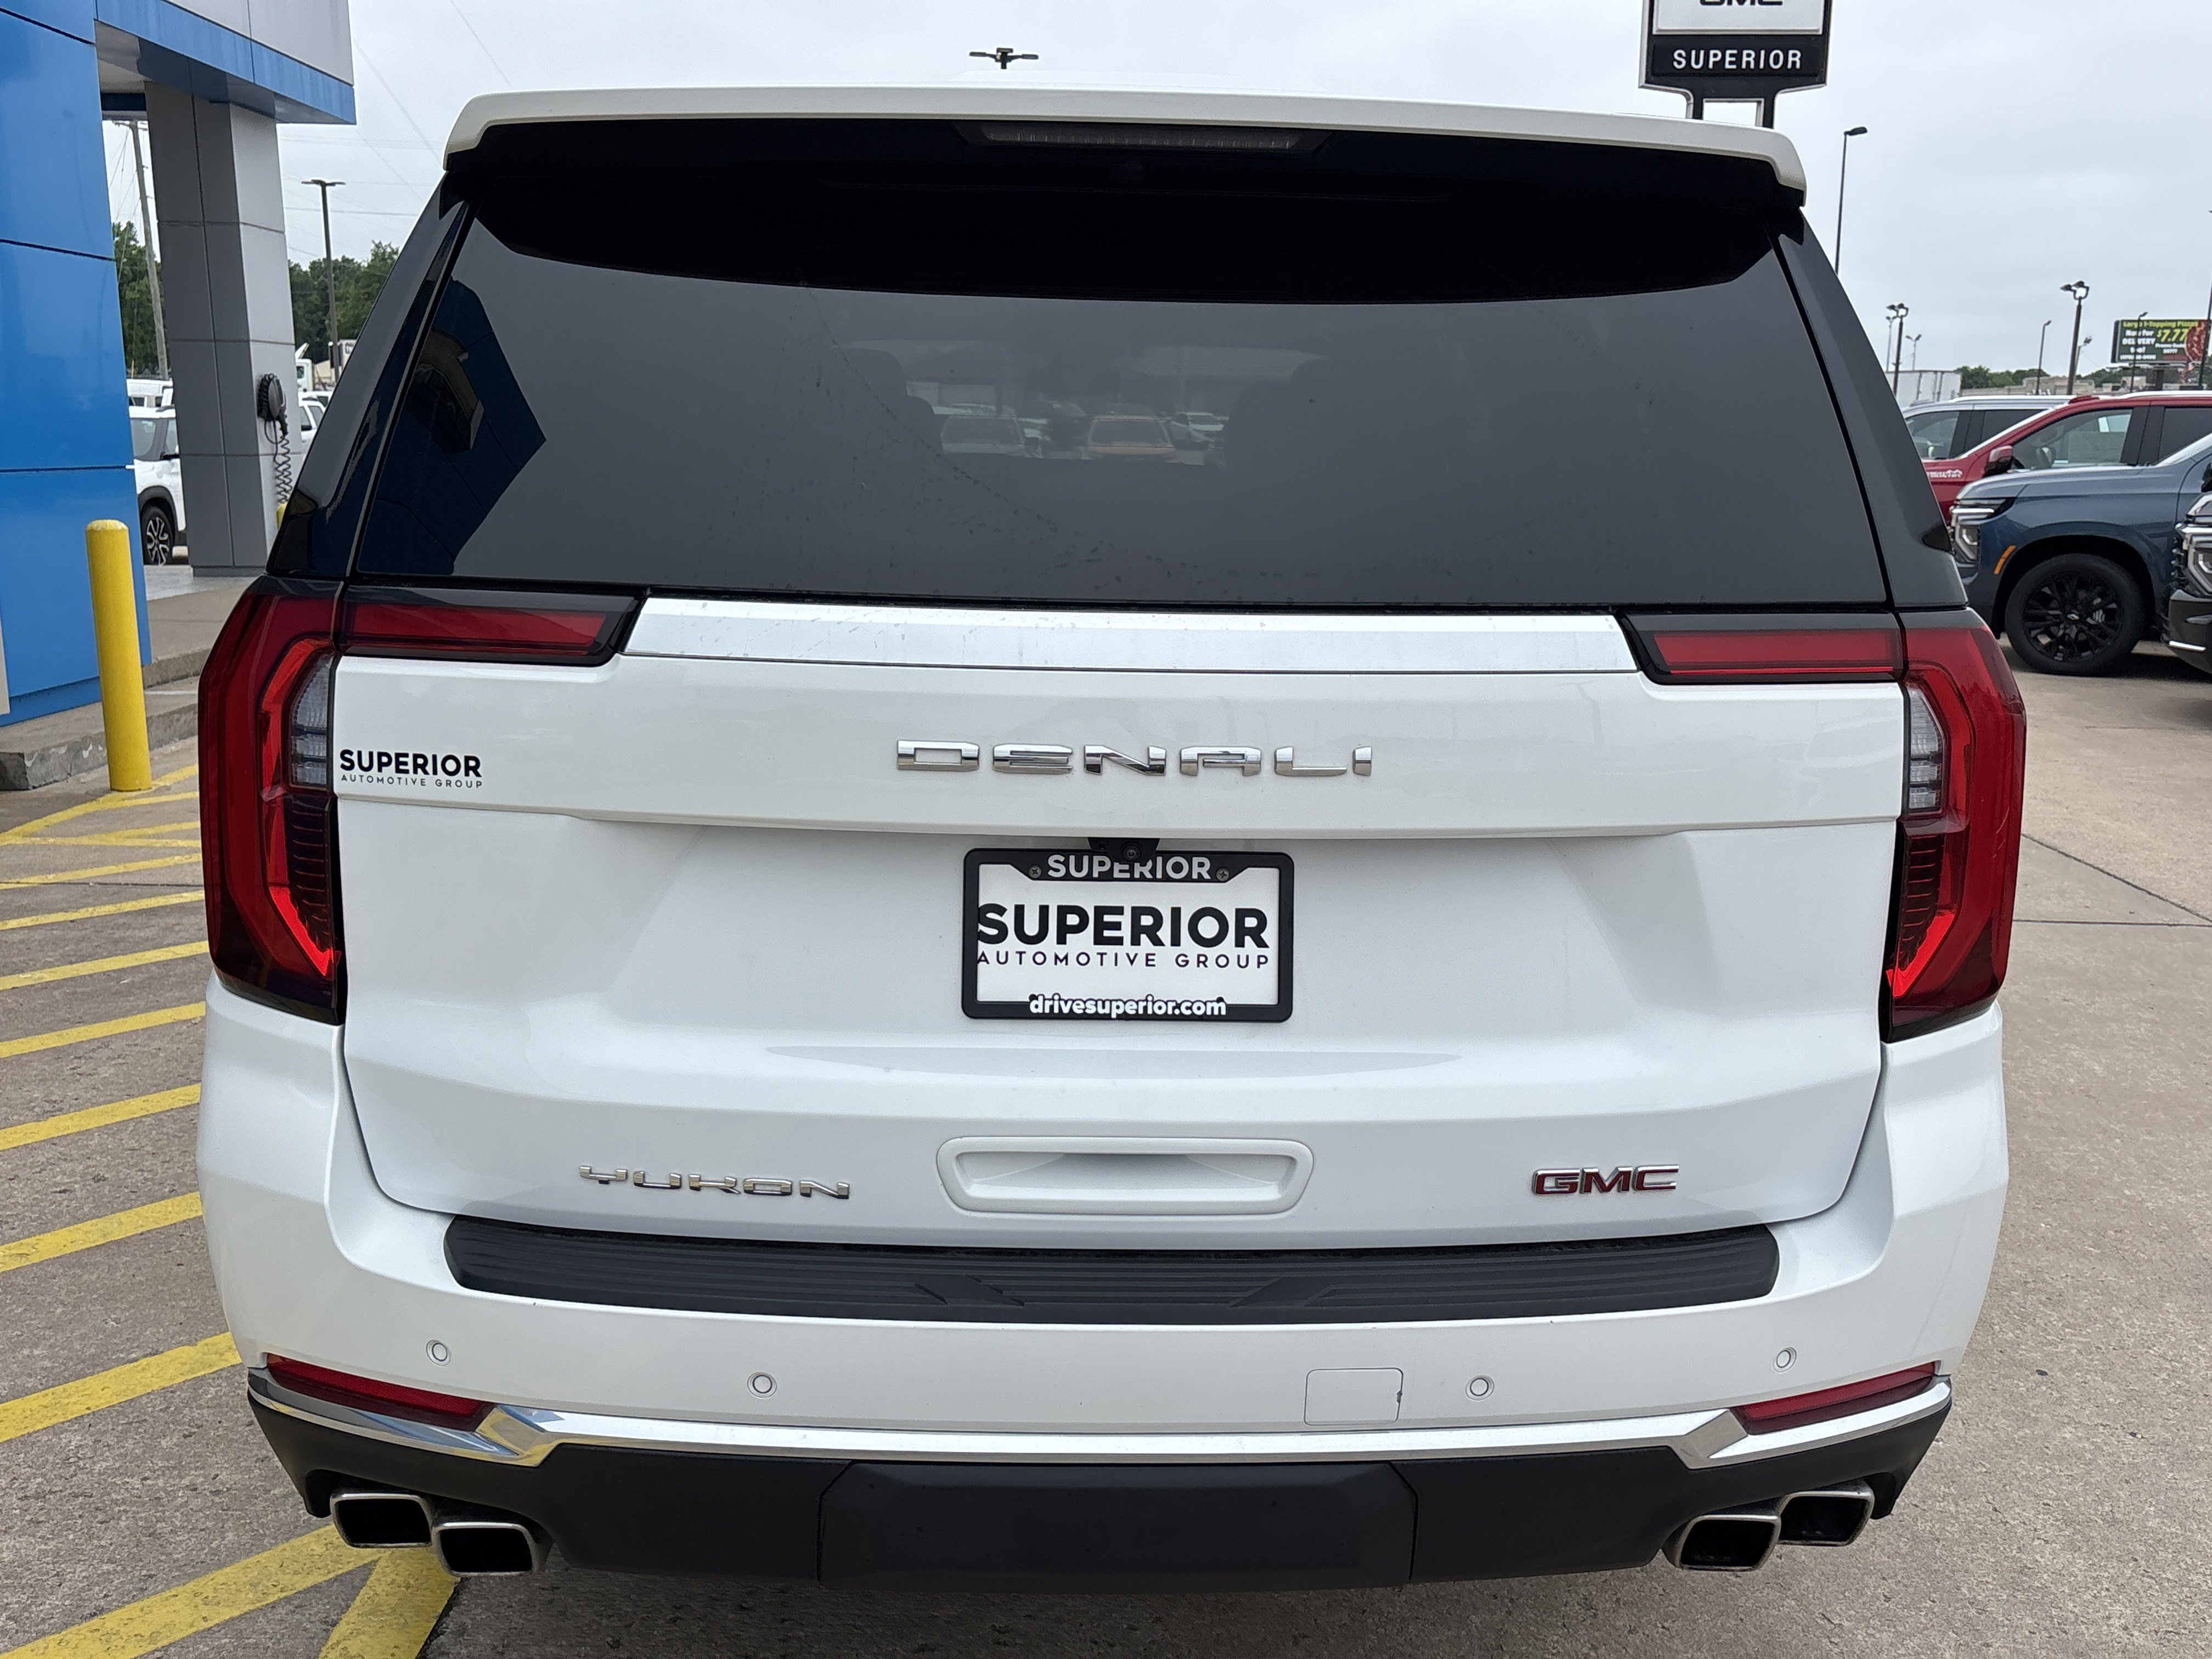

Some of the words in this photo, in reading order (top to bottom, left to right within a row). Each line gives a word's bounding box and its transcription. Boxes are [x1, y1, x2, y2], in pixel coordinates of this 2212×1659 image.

[1673, 49, 1801, 70] SUPERIOR
[2157, 329, 2190, 342] $7.77
[340, 749, 482, 777] SUPERIOR
[897, 740, 1372, 776] DENALI
[341, 774, 426, 786] AUTOMOTIVE
[435, 779, 482, 788] GROUP
[1047, 854, 1211, 879] SUPERIOR
[978, 903, 1269, 949] SUPERIOR
[977, 950, 1156, 967] AUTOMOTIVE
[1175, 953, 1268, 969] GROUP
[1029, 993, 1226, 1018] drivesuperior.com
[579, 1165, 850, 1199] YUKON
[1532, 1164, 1679, 1195] GMC
